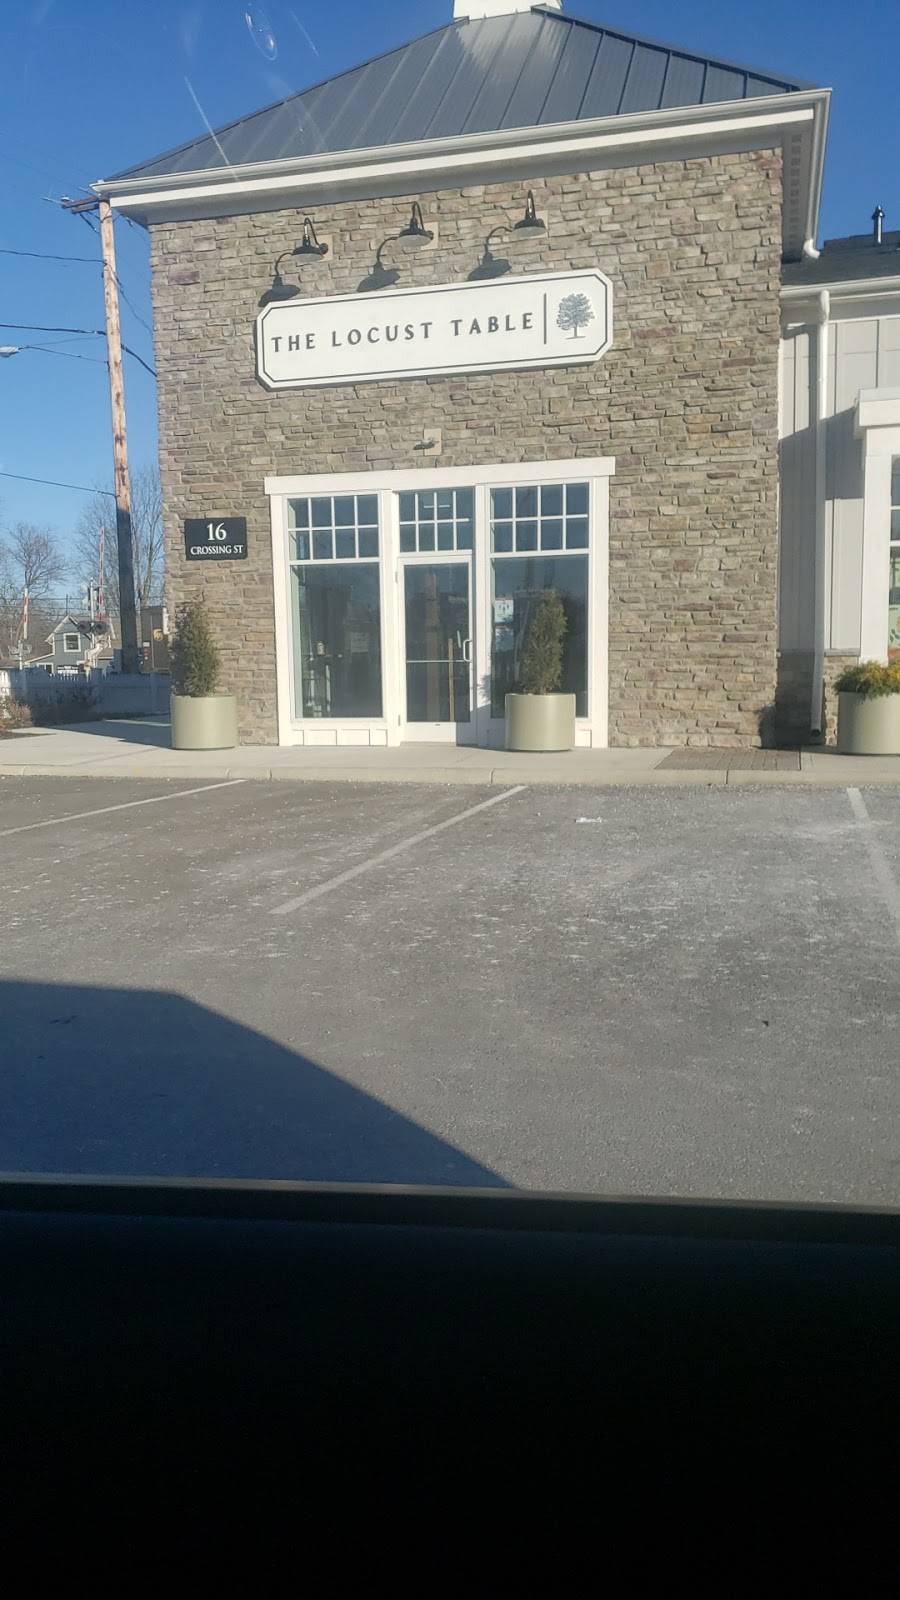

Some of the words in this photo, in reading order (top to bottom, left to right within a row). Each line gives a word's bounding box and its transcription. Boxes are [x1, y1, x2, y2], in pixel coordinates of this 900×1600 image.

[271, 333, 316, 352] THE
[331, 321, 433, 347] LOCUST
[450, 312, 534, 336] TABLE
[207, 523, 227, 541] 16
[190, 545, 232, 555] CROSSING
[233, 545, 243, 554] ST
